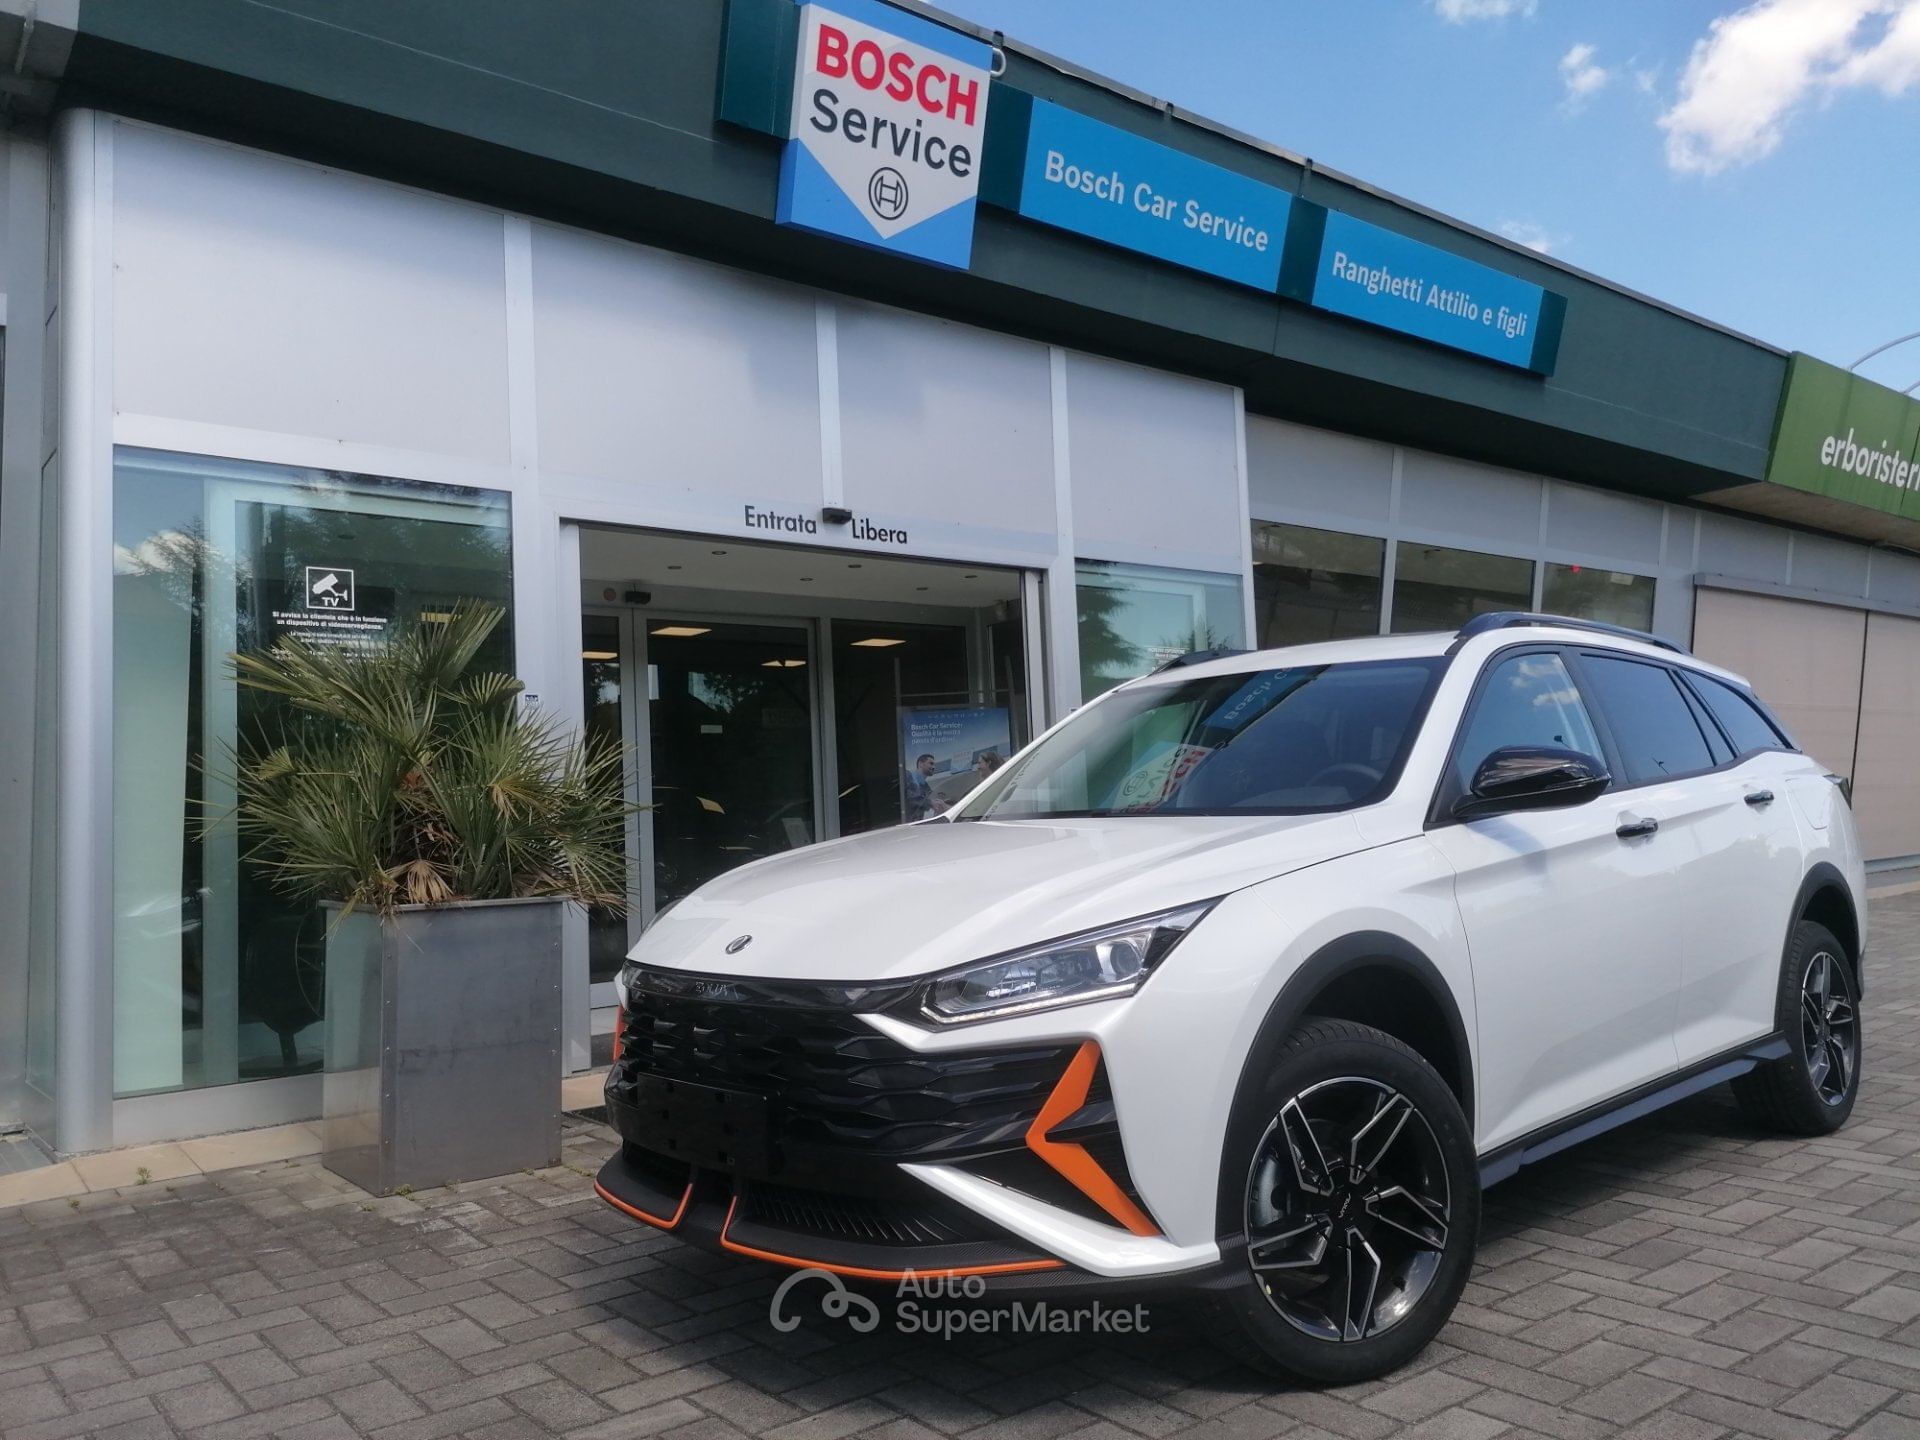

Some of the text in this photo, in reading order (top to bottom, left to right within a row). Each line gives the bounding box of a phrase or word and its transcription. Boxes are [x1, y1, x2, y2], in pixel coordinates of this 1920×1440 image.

[816, 23, 979, 126] BOSCH
[810, 88, 971, 177] Service
[1045, 150, 1268, 252] Bosch Car Service
[1332, 251, 1528, 339] Ranghetti Attilio e figli
[744, 505, 908, 544] Entrata Libera
[321, 597, 340, 607] TV
